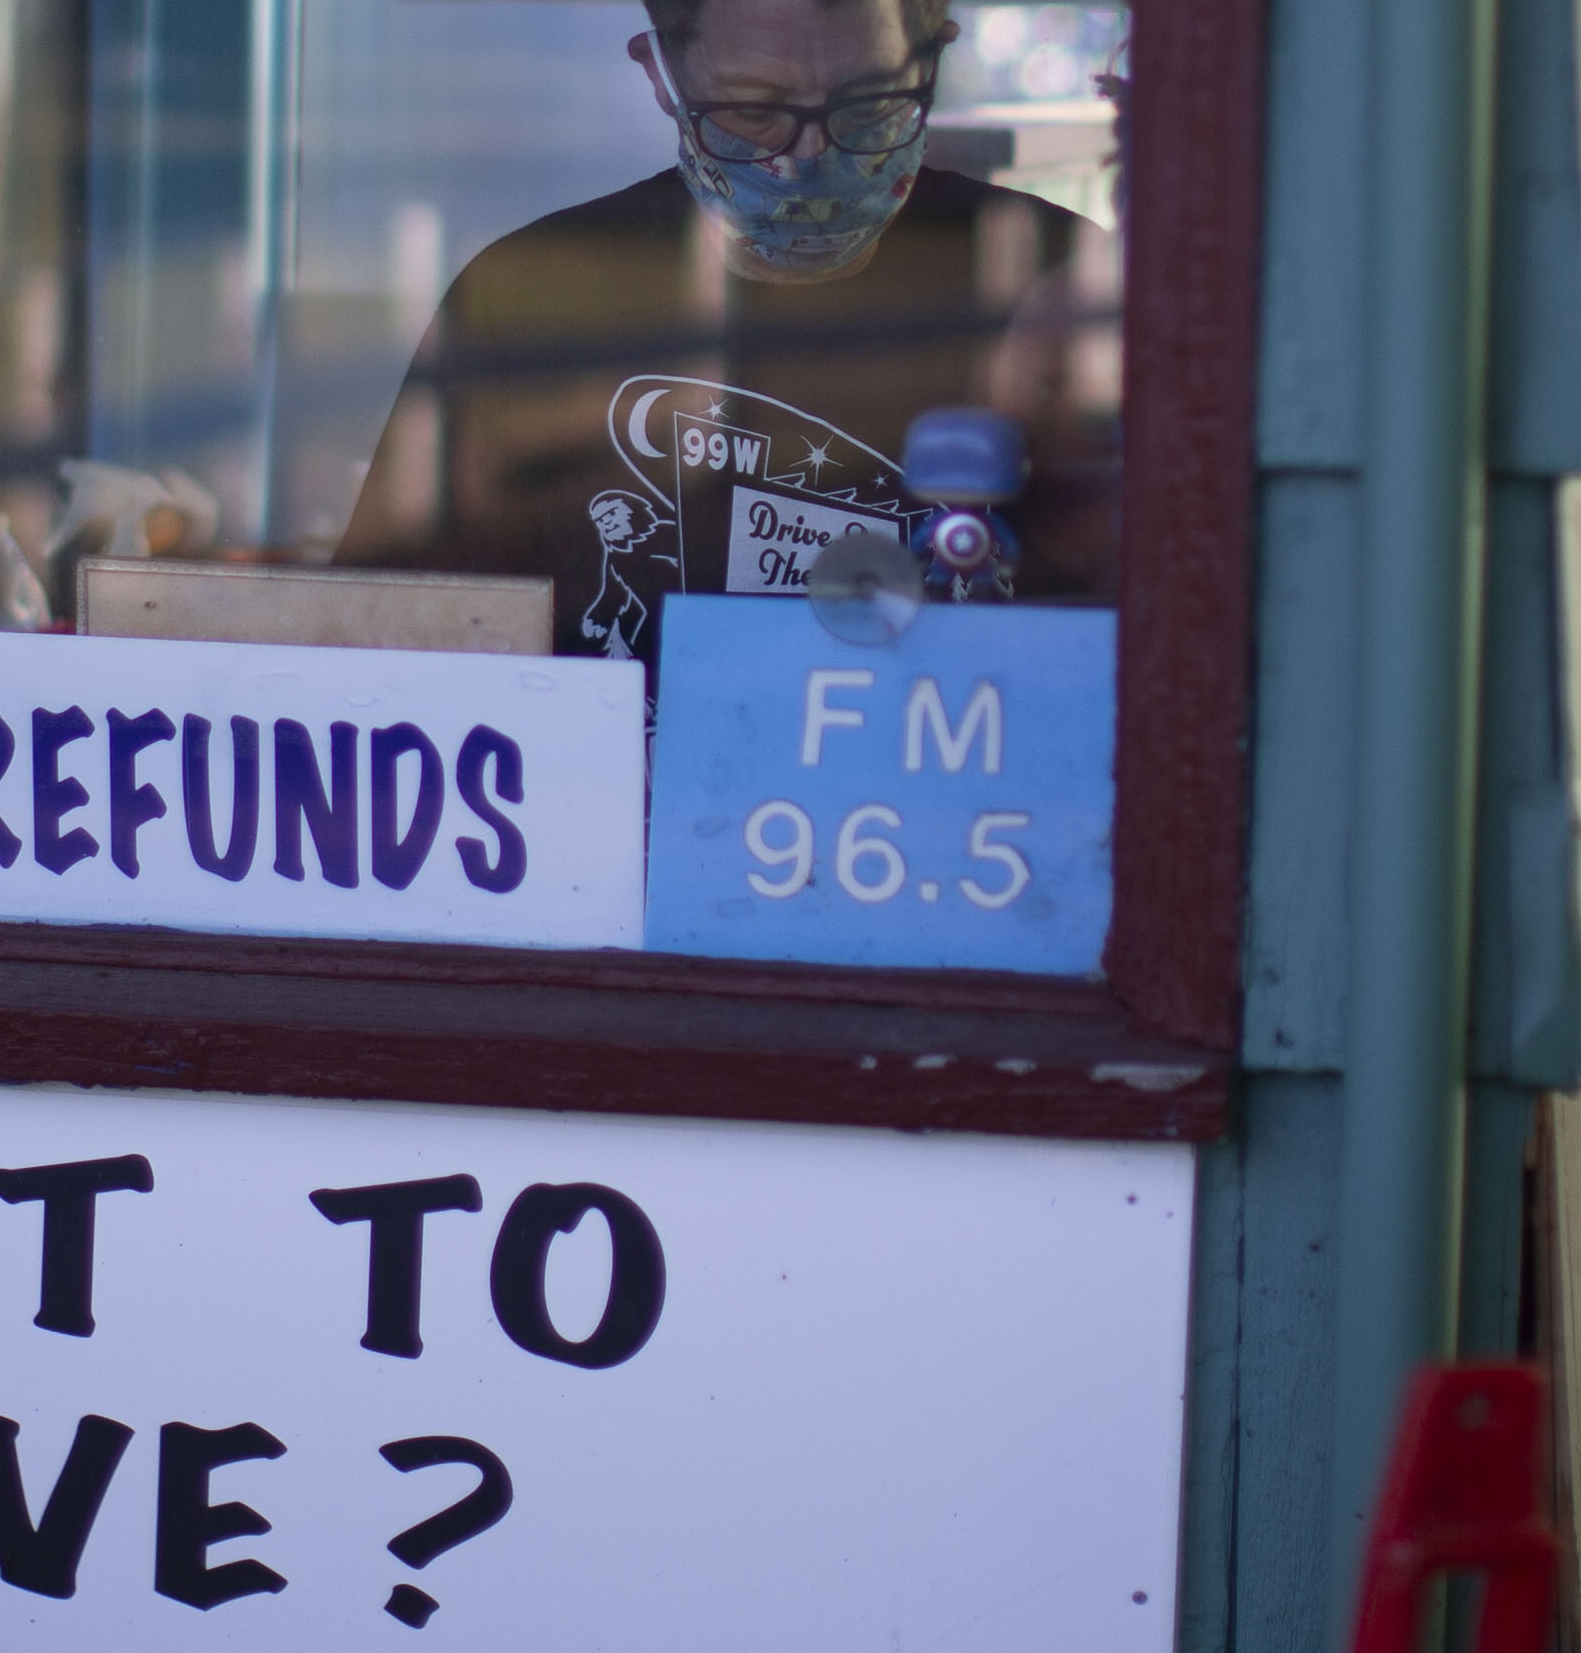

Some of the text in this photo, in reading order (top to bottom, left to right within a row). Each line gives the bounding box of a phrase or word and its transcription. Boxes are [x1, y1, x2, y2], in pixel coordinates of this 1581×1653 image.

[681, 427, 762, 476] 99W
[749, 500, 834, 548] Drive
[801, 670, 1002, 774] FM
[744, 801, 1031, 909] 96.5
[308, 1173, 667, 1370] TO
